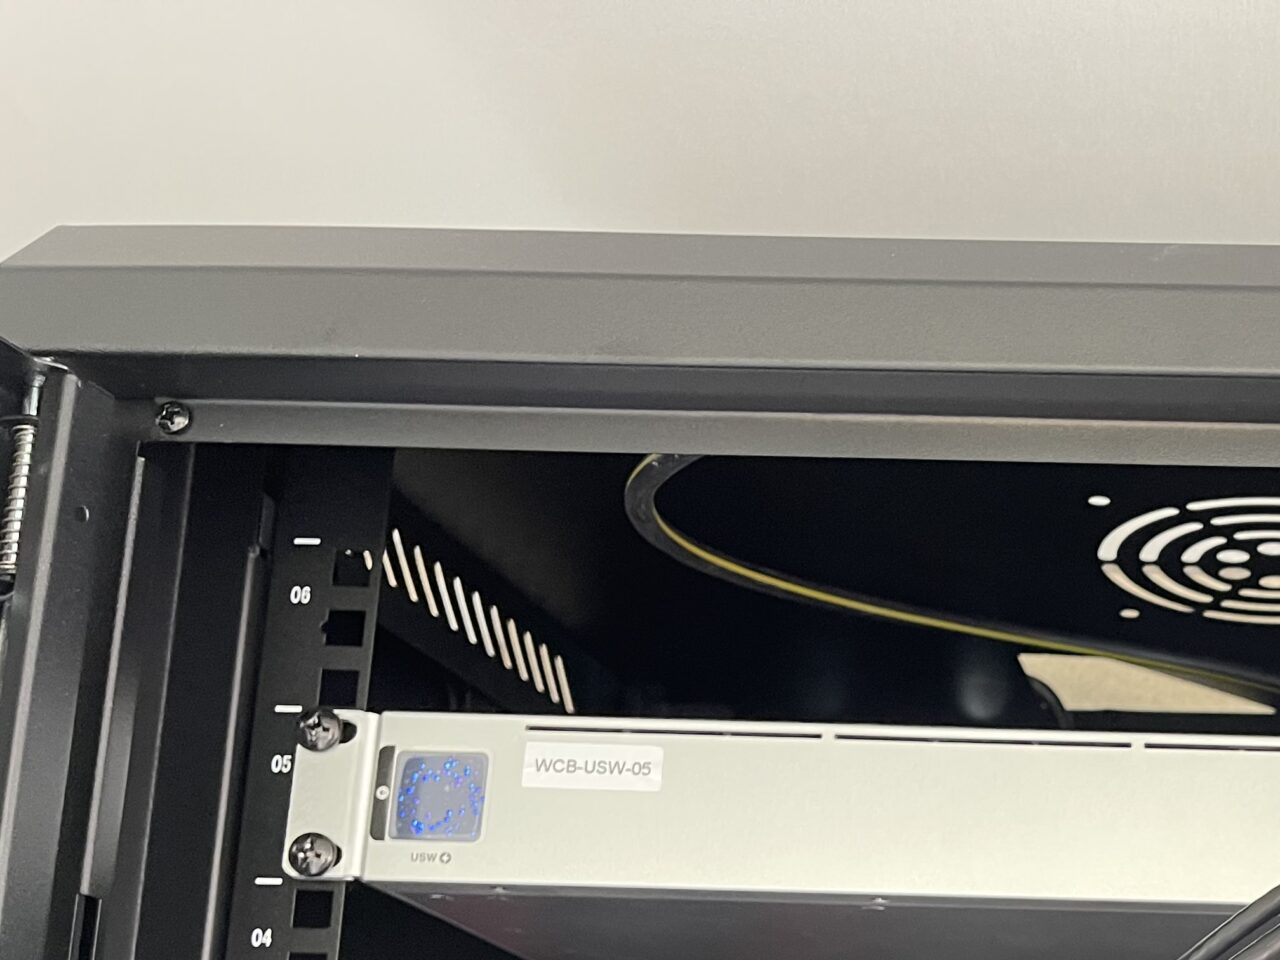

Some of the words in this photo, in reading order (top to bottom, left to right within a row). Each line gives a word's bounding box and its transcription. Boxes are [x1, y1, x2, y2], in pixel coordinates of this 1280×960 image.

[289, 585, 312, 605] 06
[270, 754, 293, 774] 05
[535, 757, 653, 776] WCB-USW-05
[410, 852, 438, 862] USW
[250, 927, 273, 948] 04
